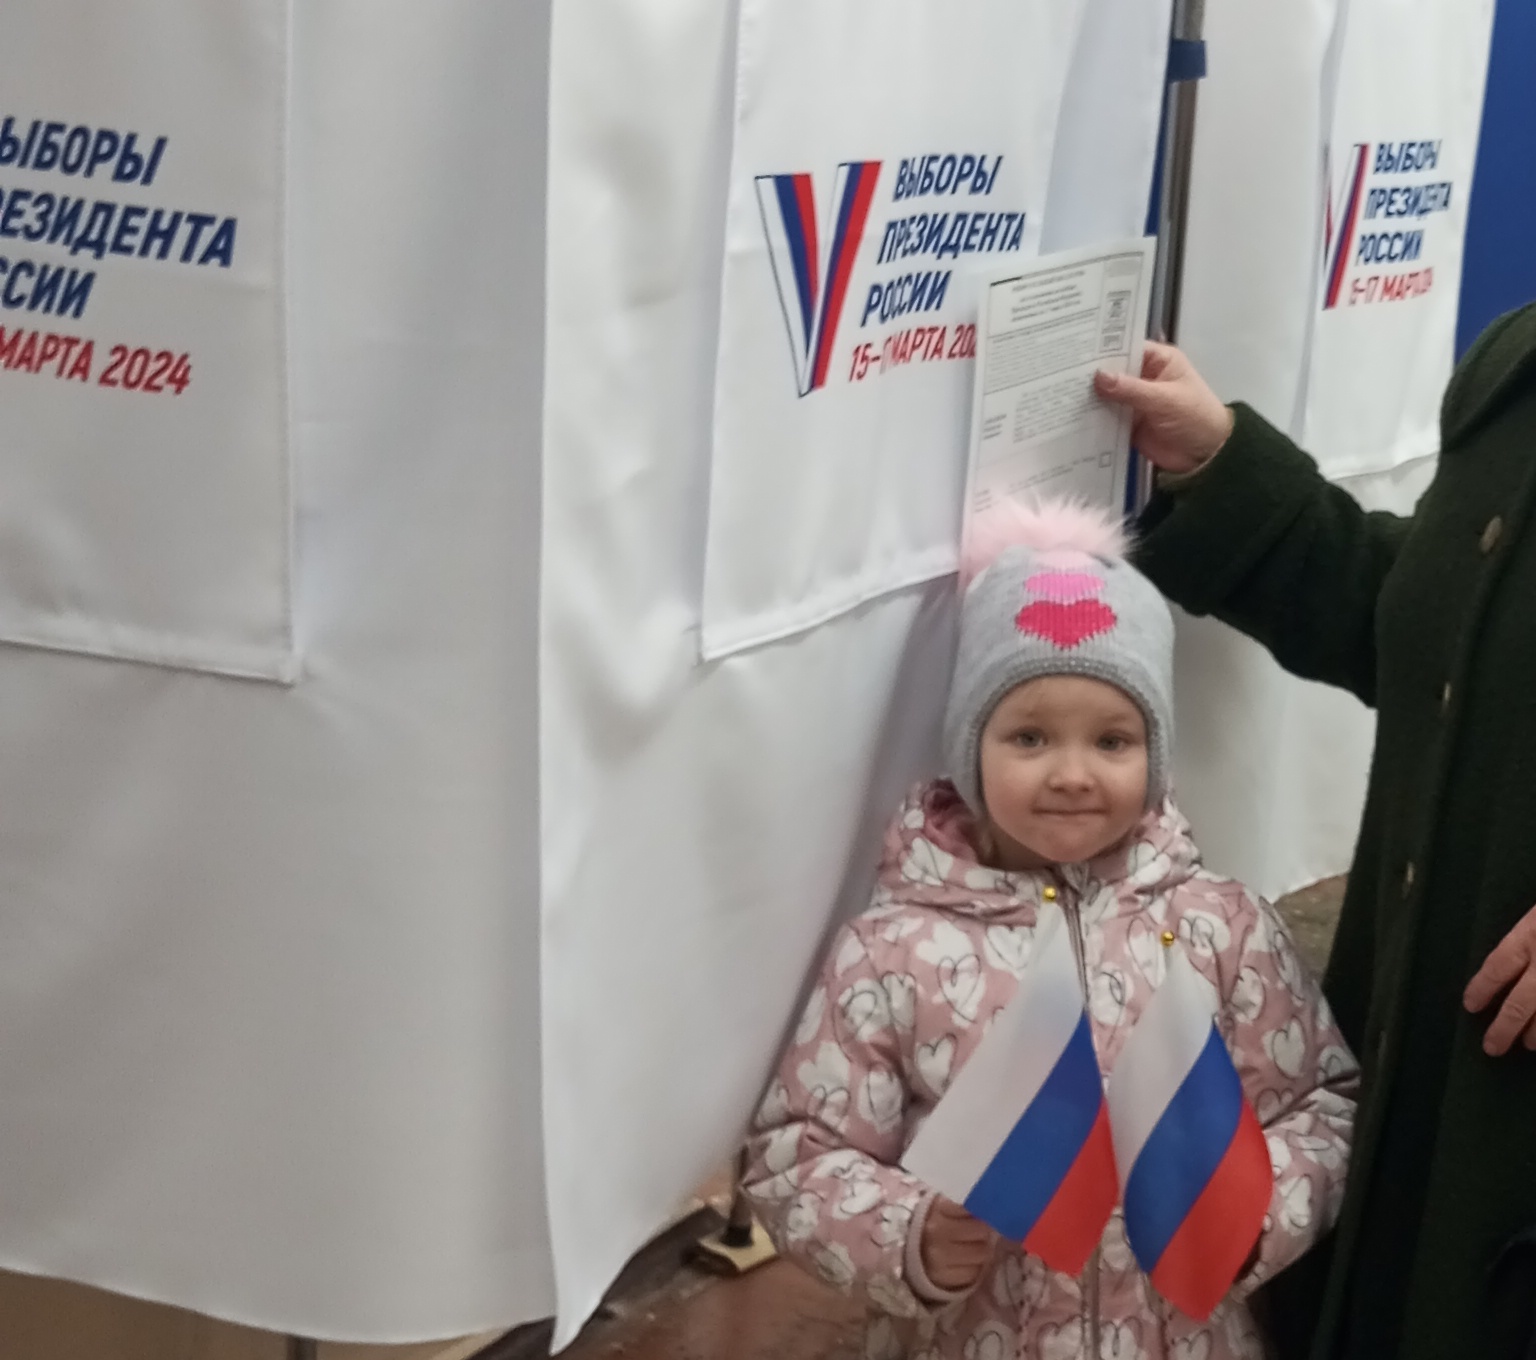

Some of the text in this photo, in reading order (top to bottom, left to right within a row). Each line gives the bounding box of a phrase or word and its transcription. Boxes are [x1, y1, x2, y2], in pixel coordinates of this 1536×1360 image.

[892, 153, 1003, 202] ВЫБОРЫ
[0, 187, 238, 268] ЕЗИДЕНТА
[876, 211, 1026, 265] ПРЕЗИДЕНТА
[860, 269, 952, 327] РОССИИ
[98, 343, 192, 395] 2024
